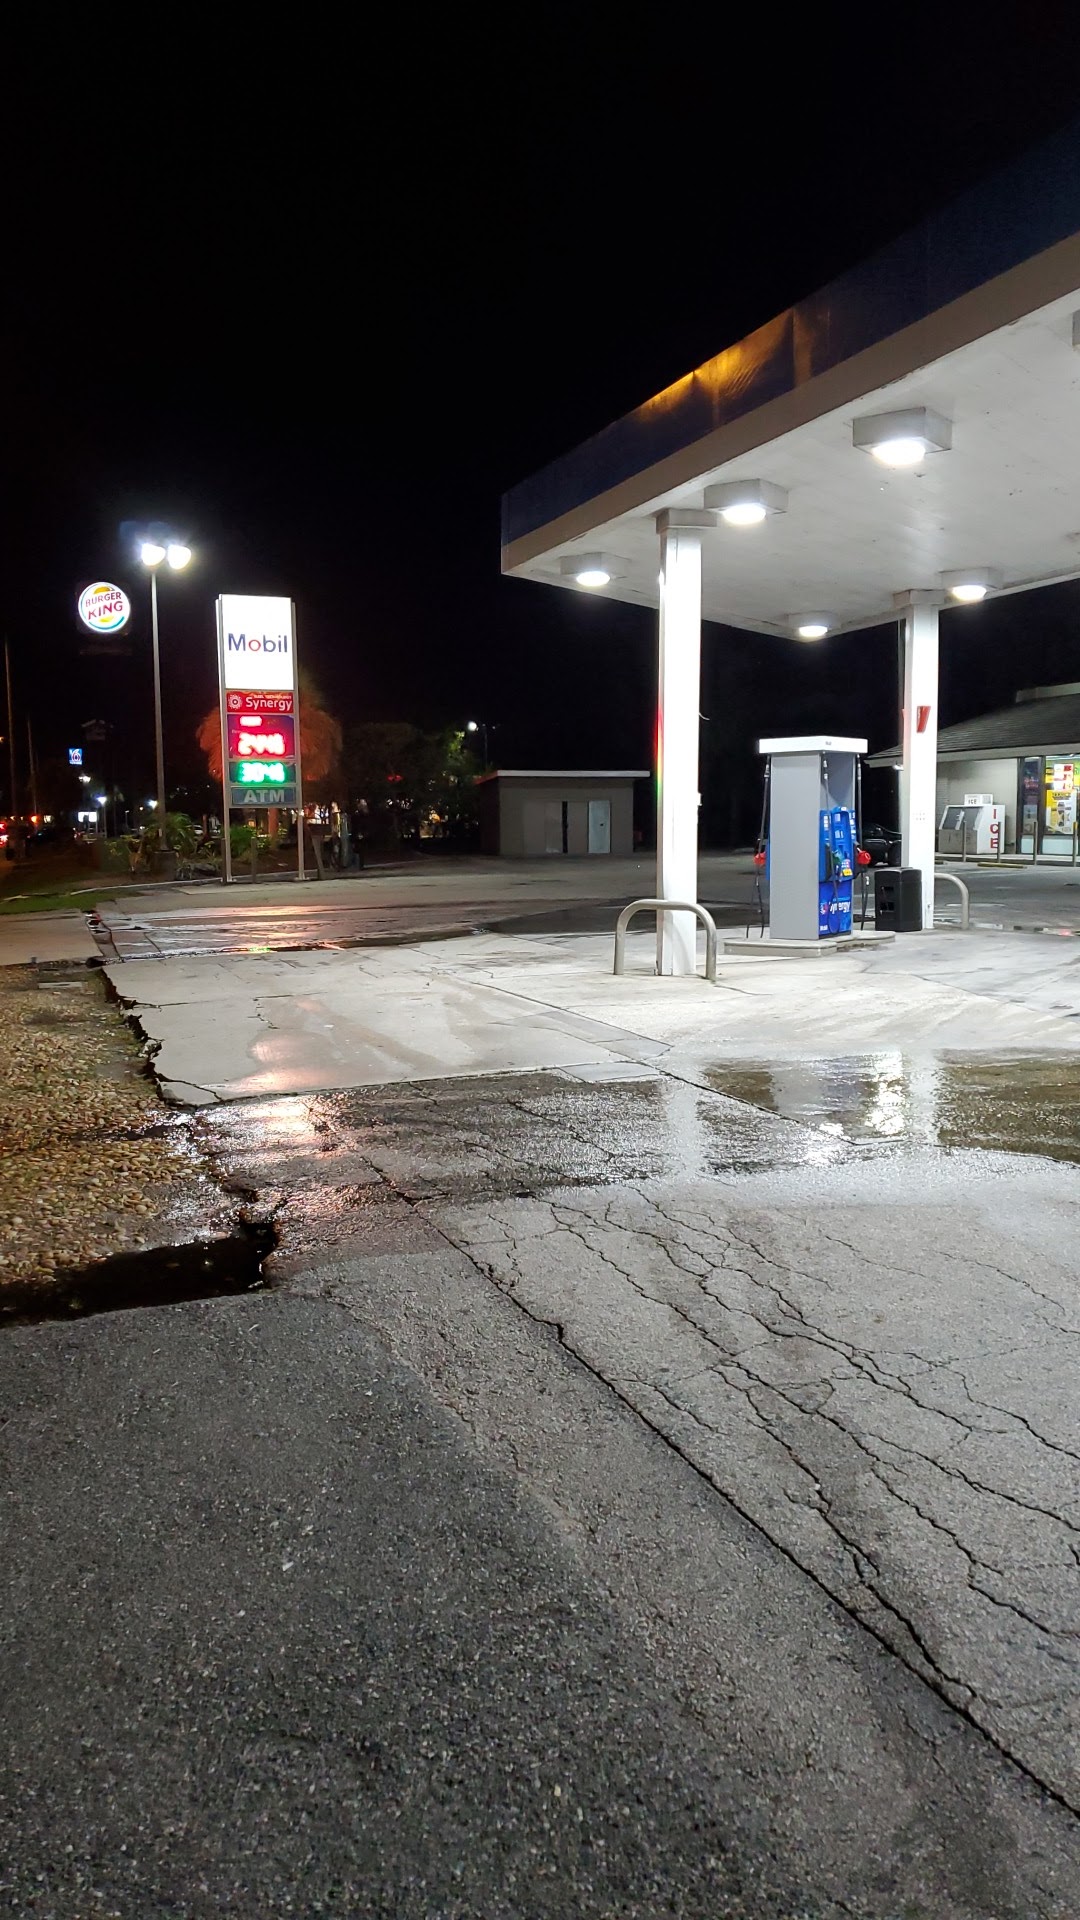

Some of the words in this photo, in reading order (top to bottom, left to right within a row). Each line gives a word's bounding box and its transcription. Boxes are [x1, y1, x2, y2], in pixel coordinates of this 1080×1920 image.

[86, 591, 122, 607] BURGER
[88, 600, 123, 620] KING
[228, 632, 288, 653] Mobil
[246, 697, 293, 712] Synergy
[243, 789, 285, 803] ATM
[990, 808, 1000, 848] ICE
